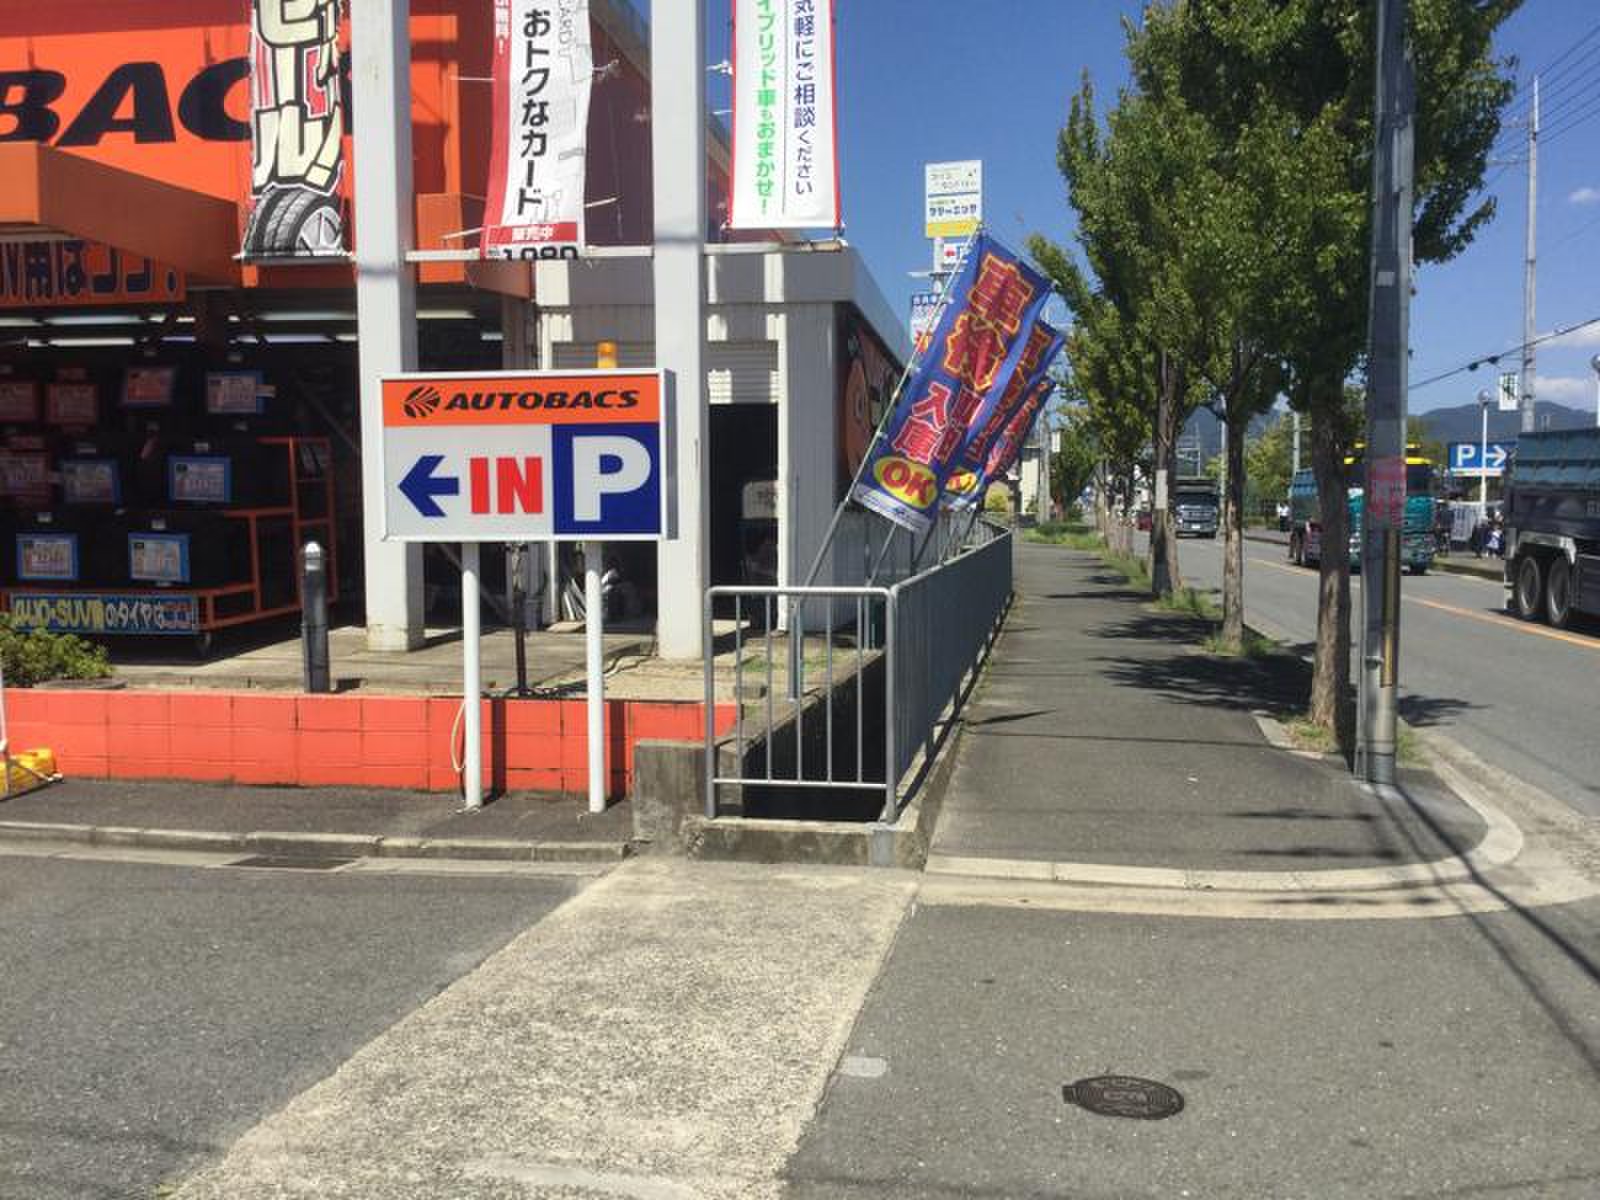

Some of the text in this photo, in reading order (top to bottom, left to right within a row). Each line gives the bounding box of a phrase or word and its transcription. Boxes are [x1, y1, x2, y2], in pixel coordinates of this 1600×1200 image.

[515, 8, 551, 217] おトクなカード
[793, 0, 815, 195] 気軽にご相談ください
[444, 389, 640, 410] AUTOBACS
[469, 455, 544, 515] IN
[572, 435, 652, 522] P
[882, 461, 932, 506] OK
[1456, 443, 1477, 467] P
